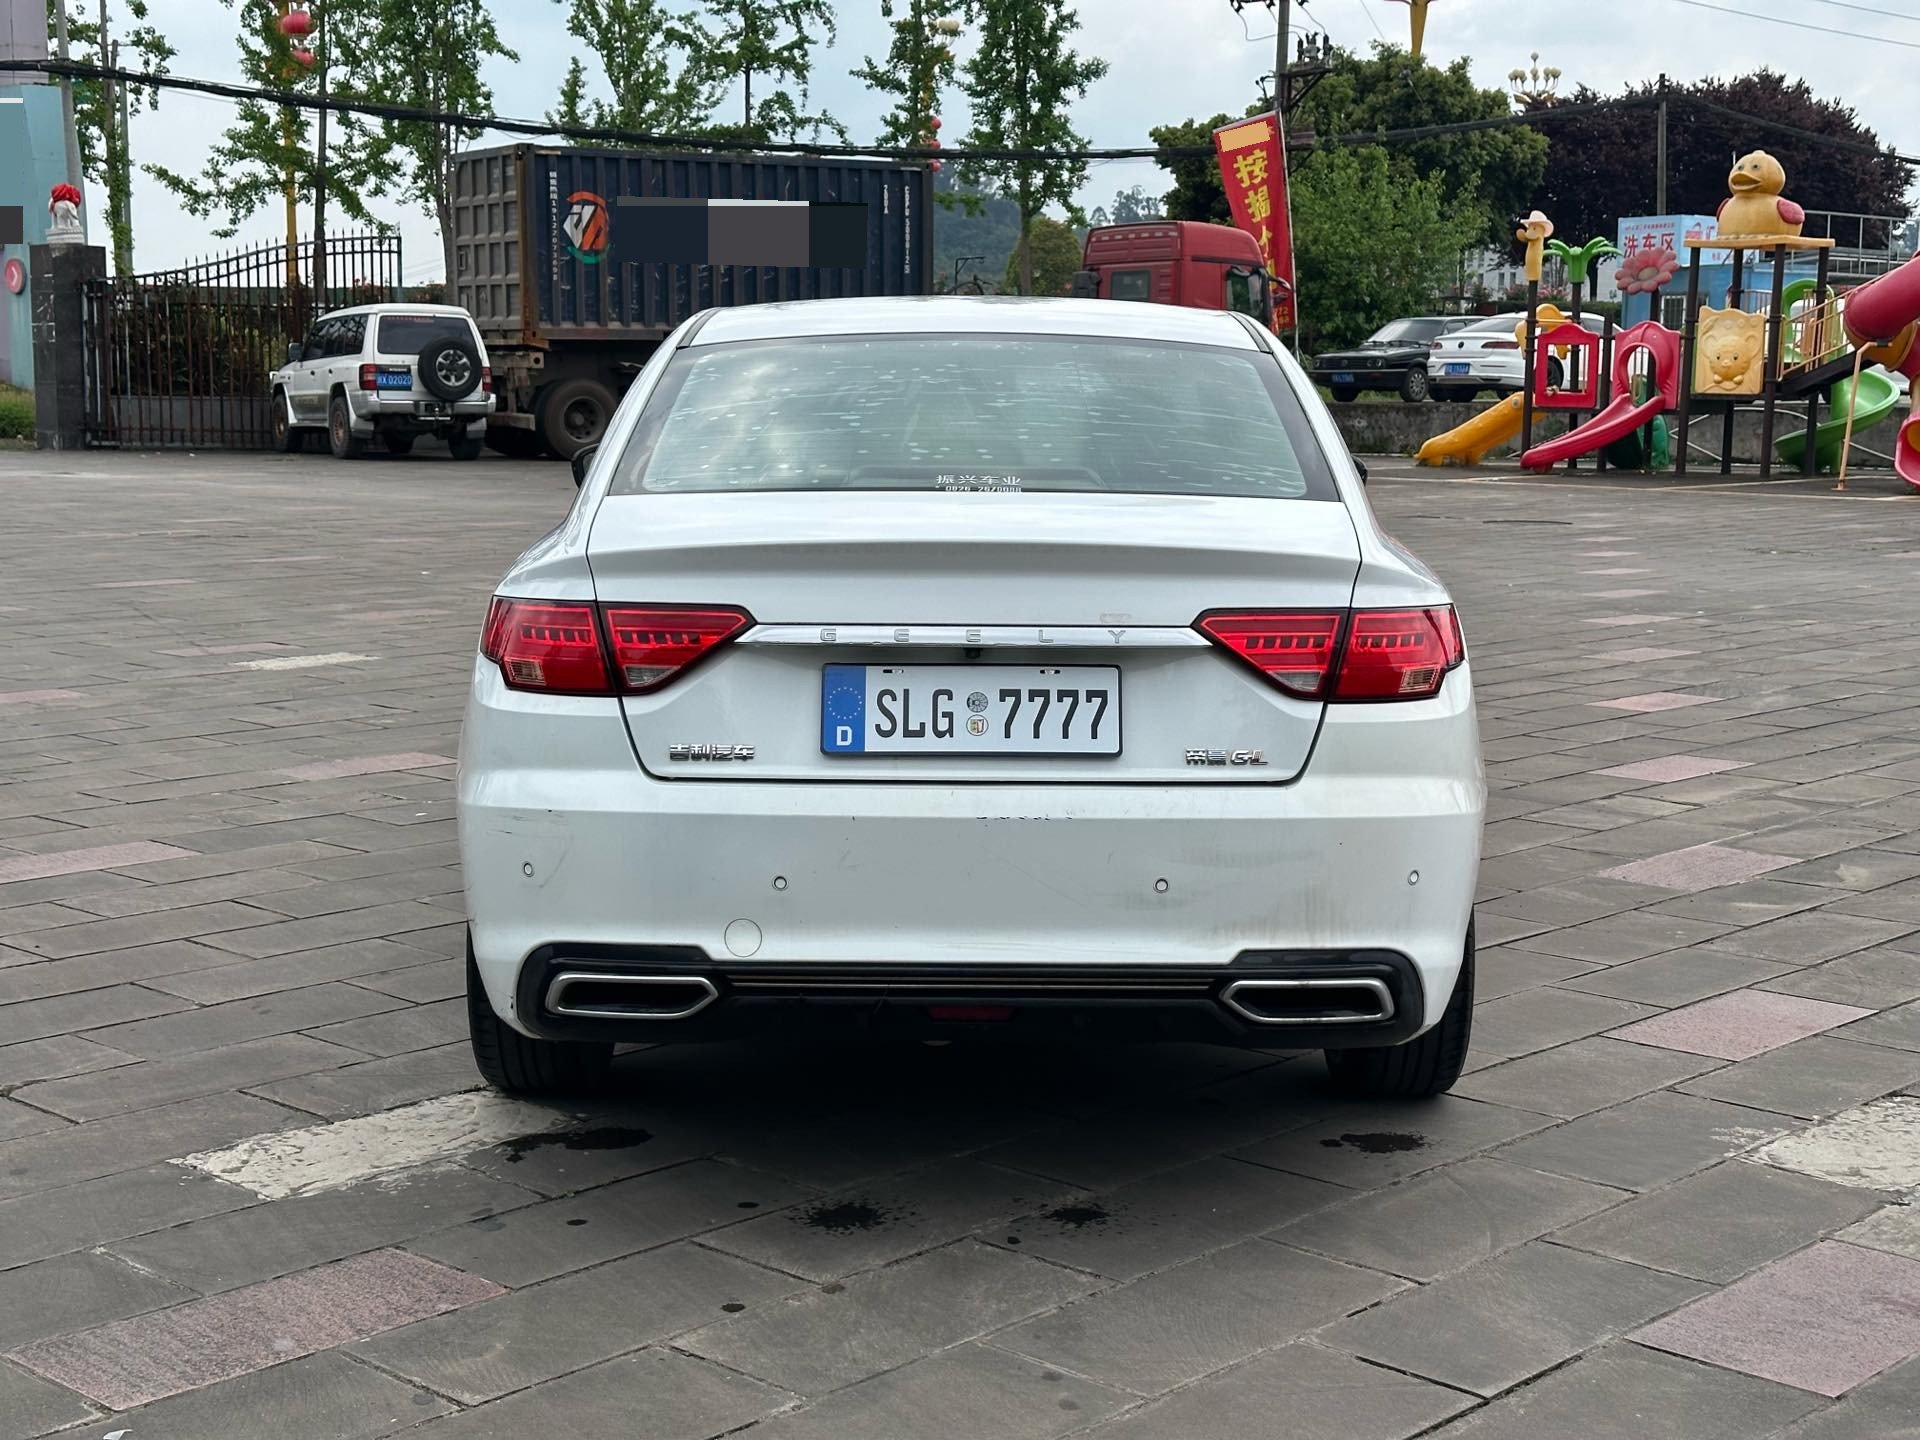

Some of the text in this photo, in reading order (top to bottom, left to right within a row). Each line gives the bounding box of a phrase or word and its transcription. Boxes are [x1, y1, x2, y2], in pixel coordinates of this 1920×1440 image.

[1623, 232, 1675, 258] 洗车区
[936, 475, 1021, 486] 振兴车业
[819, 627, 1126, 644] GEELY
[874, 688, 1109, 740] SLG 7777
[836, 725, 852, 746] D
[669, 743, 755, 761] 吉利汽车
[1230, 749, 1269, 766] GL
